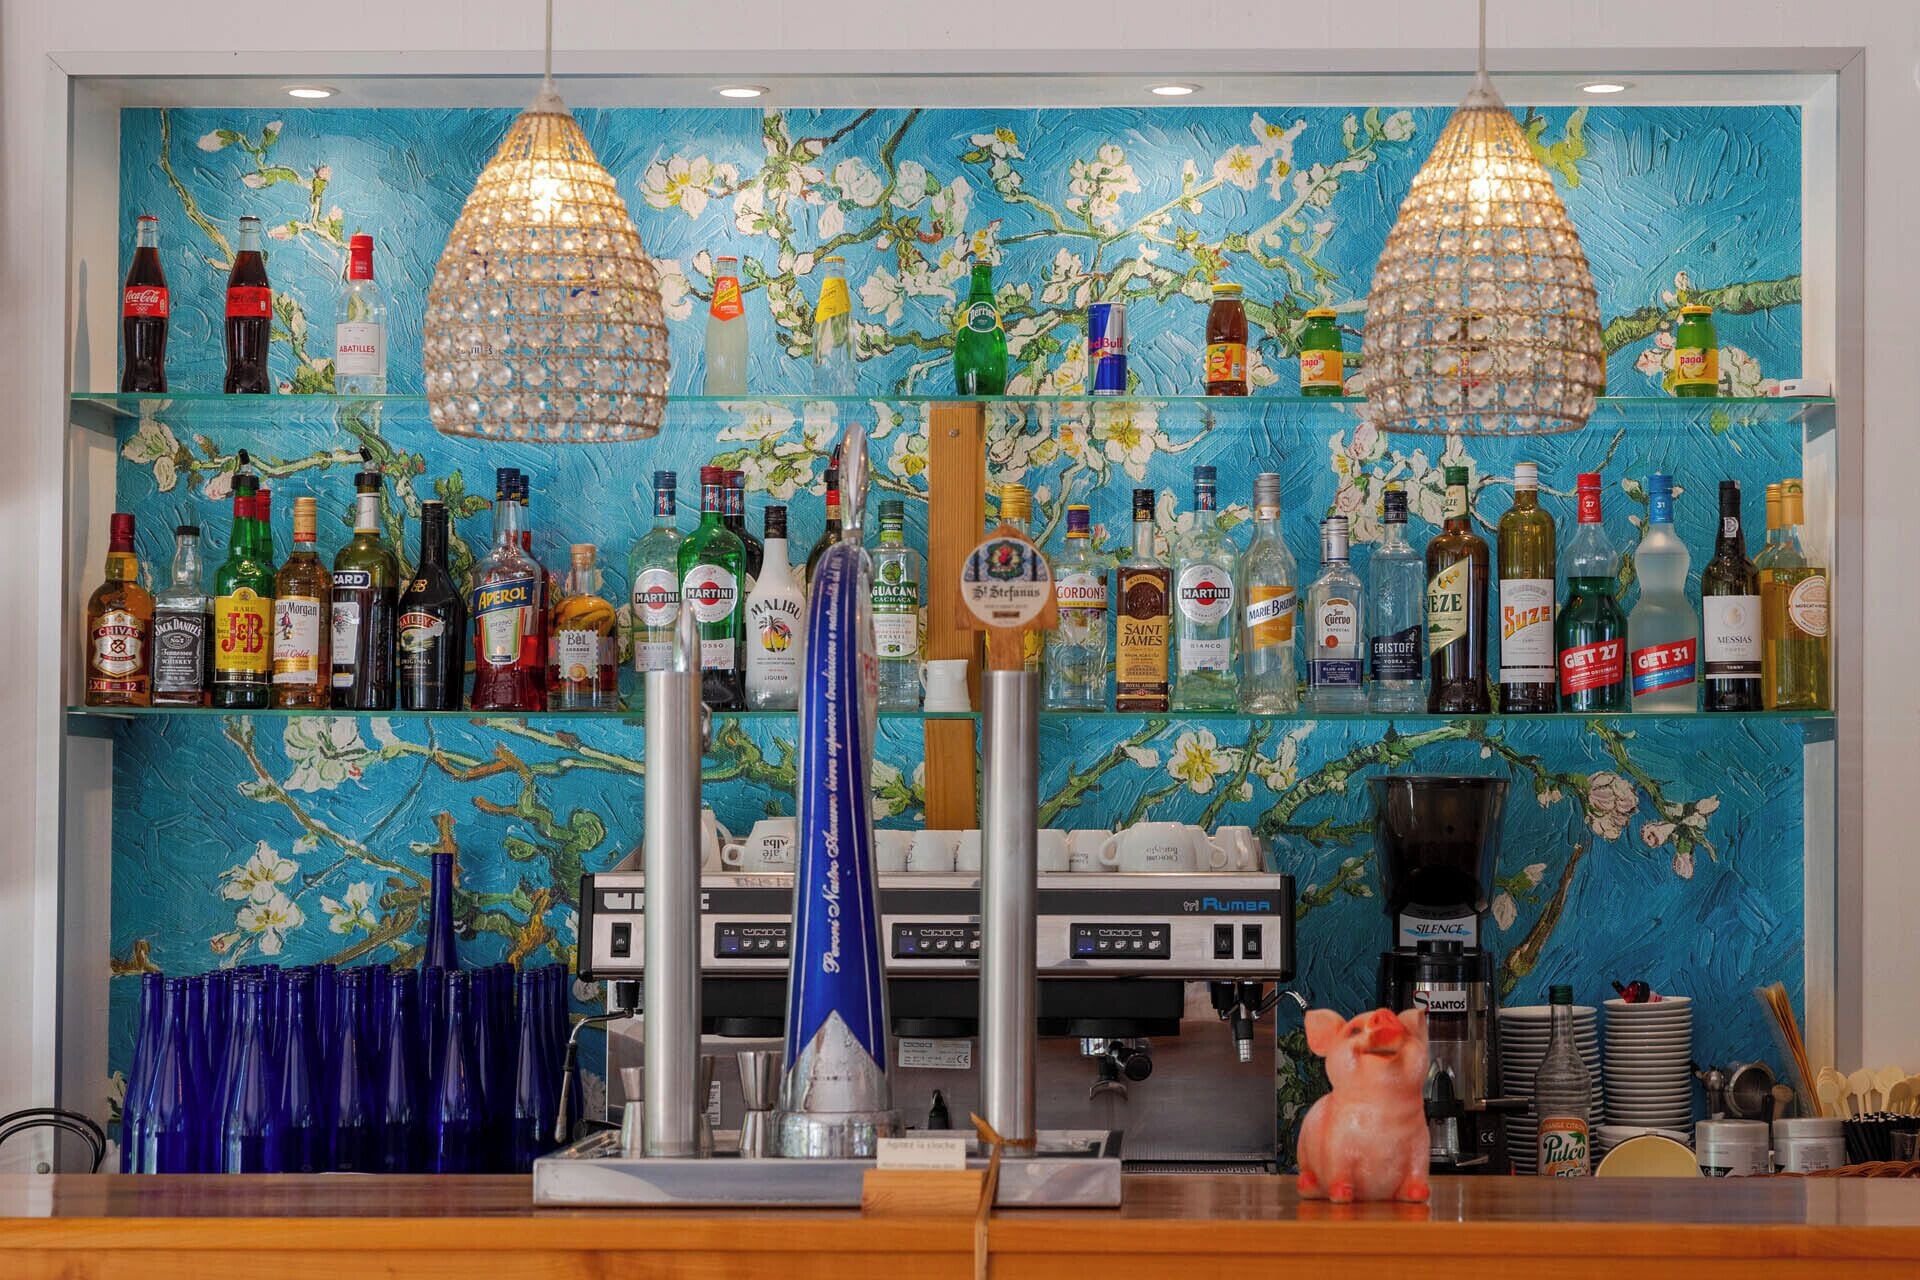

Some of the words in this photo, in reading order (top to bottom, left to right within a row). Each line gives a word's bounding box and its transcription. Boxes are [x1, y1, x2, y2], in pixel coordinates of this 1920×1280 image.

[126, 289, 160, 303] Coca-Cola
[1102, 337, 1123, 348] Bull
[339, 345, 375, 353] ABATILLES
[1585, 500, 1595, 508] 27
[1657, 501, 1666, 509] 31
[334, 574, 364, 585] CARD
[478, 586, 527, 611] APEROL
[636, 592, 679, 604] MARTINI
[687, 588, 732, 599] MARTINI
[990, 585, 1041, 602] Stefanus
[1183, 588, 1229, 599] MARTINI
[288, 601, 317, 617] Morgan
[751, 598, 802, 621] MALIBU
[1248, 604, 1271, 621] MARIE
[1324, 613, 1351, 626] Cuervo
[98, 625, 139, 638] CHIVAS
[155, 621, 173, 637] JACK
[221, 612, 264, 654] J&B
[1124, 624, 1162, 635] SAINT
[1121, 636, 1162, 647] JAMES
[1717, 636, 1753, 644] MESSIAS
[1374, 642, 1415, 653] ERISTOFF
[1564, 648, 1596, 669] GET
[1599, 643, 1618, 661] 27
[1638, 650, 1669, 669] GET
[1672, 646, 1689, 661] 31
[126, 681, 137, 691] 12
[822, 860, 841, 917] Nastro
[1415, 923, 1464, 935] SILENCE
[823, 918, 841, 974] Peroni
[1430, 1000, 1466, 1010] SANTOS
[1543, 1134, 1585, 1165] Pulco
